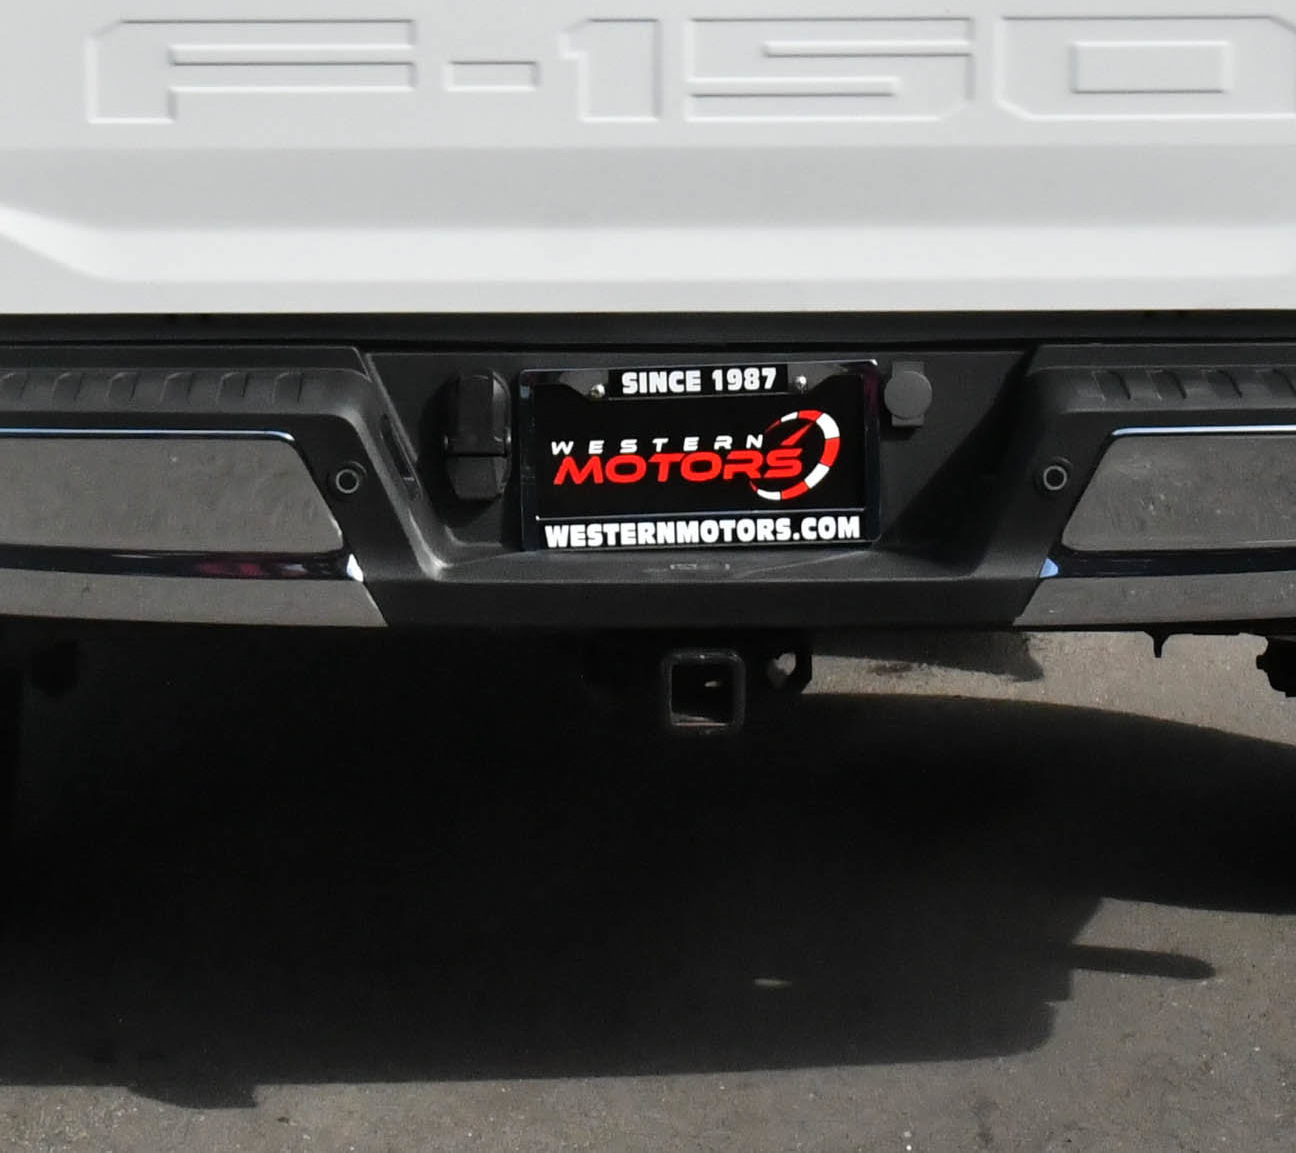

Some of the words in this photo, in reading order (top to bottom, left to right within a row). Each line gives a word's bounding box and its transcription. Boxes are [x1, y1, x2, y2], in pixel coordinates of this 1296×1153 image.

[621, 369, 702, 395] SINCE
[712, 367, 777, 392] 1987
[551, 433, 764, 456] WESTERN
[553, 448, 803, 486] MOTORS
[544, 515, 861, 548] WESTERNMOTORS.COM
